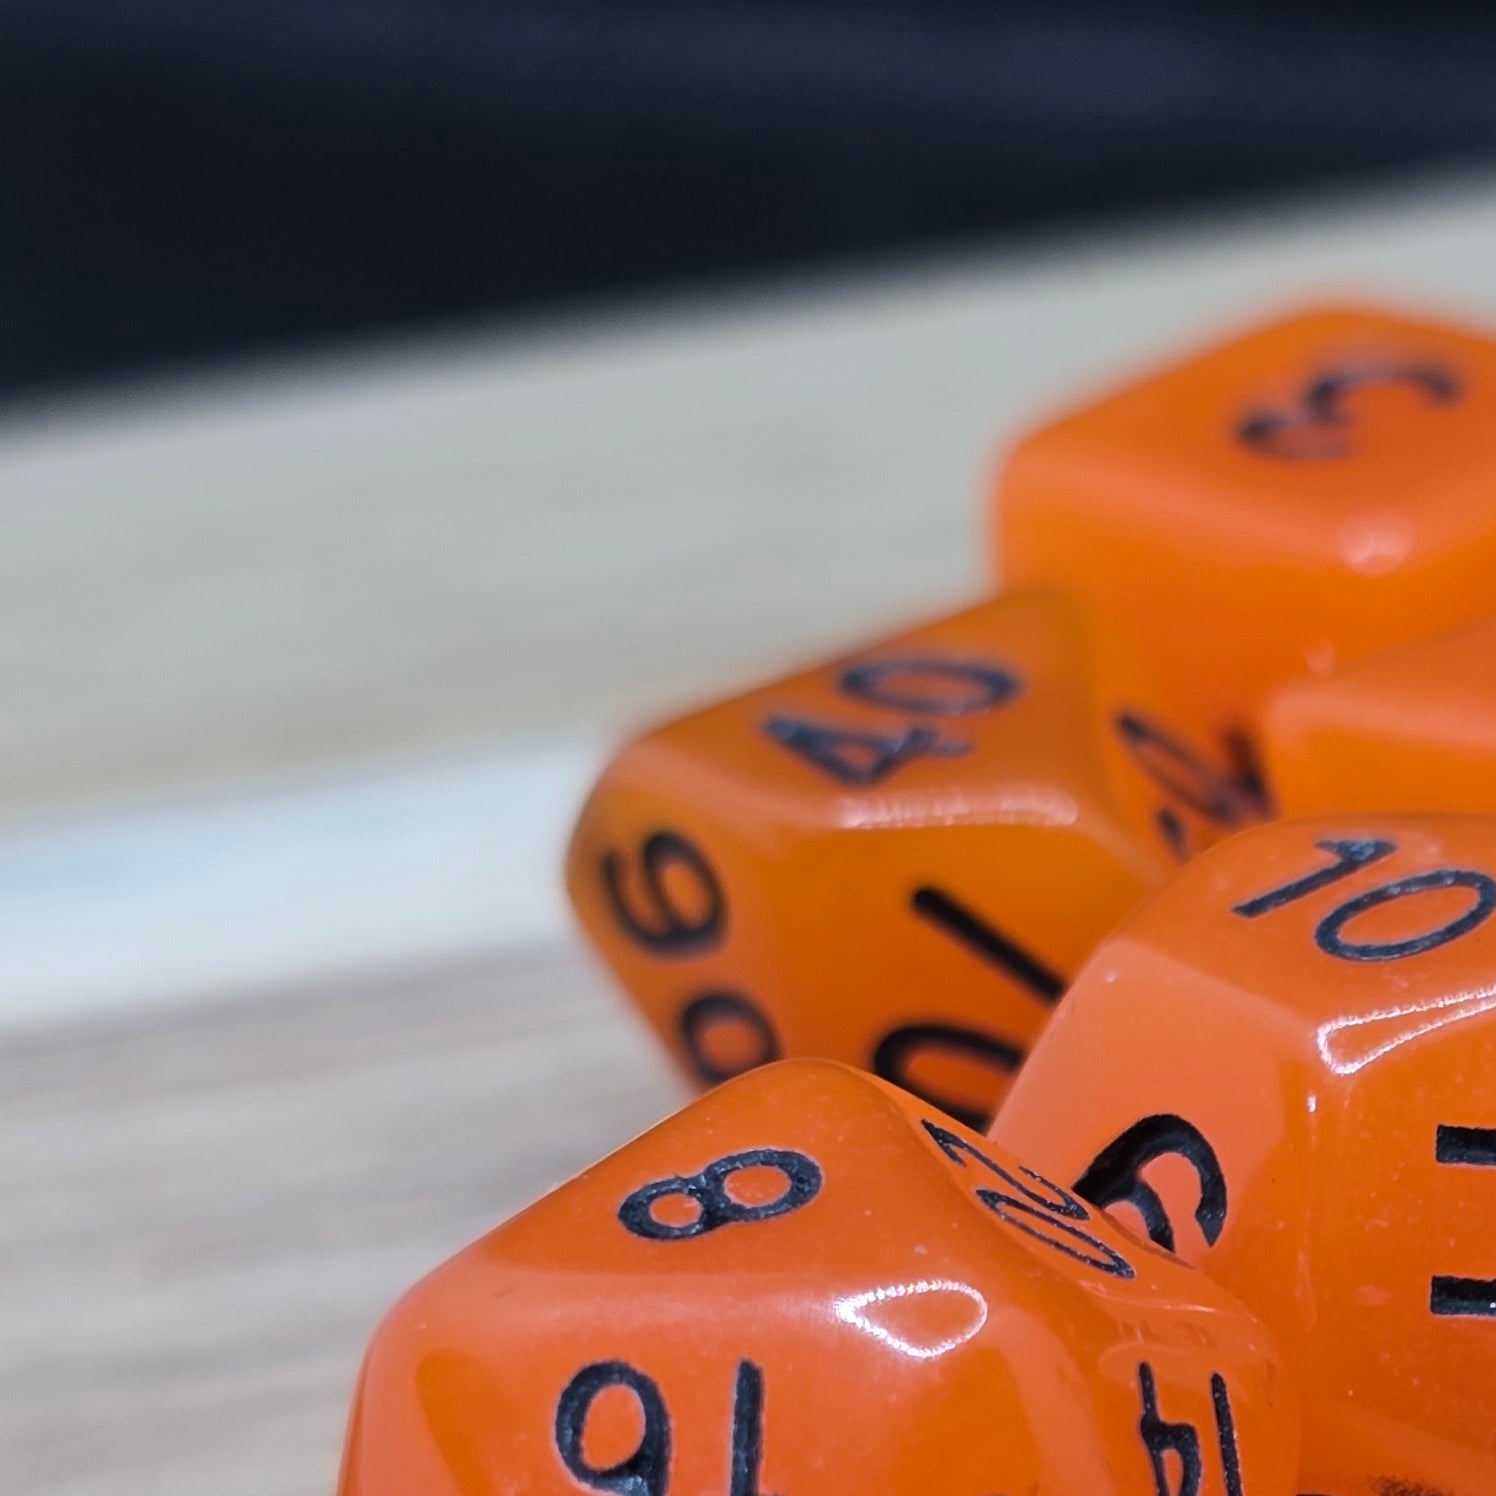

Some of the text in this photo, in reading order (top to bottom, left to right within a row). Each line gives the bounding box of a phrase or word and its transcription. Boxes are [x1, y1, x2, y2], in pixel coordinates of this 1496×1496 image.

[762, 652, 1026, 792] 40
[600, 828, 785, 1088] 90
[616, 1148, 823, 1241] 8
[921, 1117, 1137, 1279] 20
